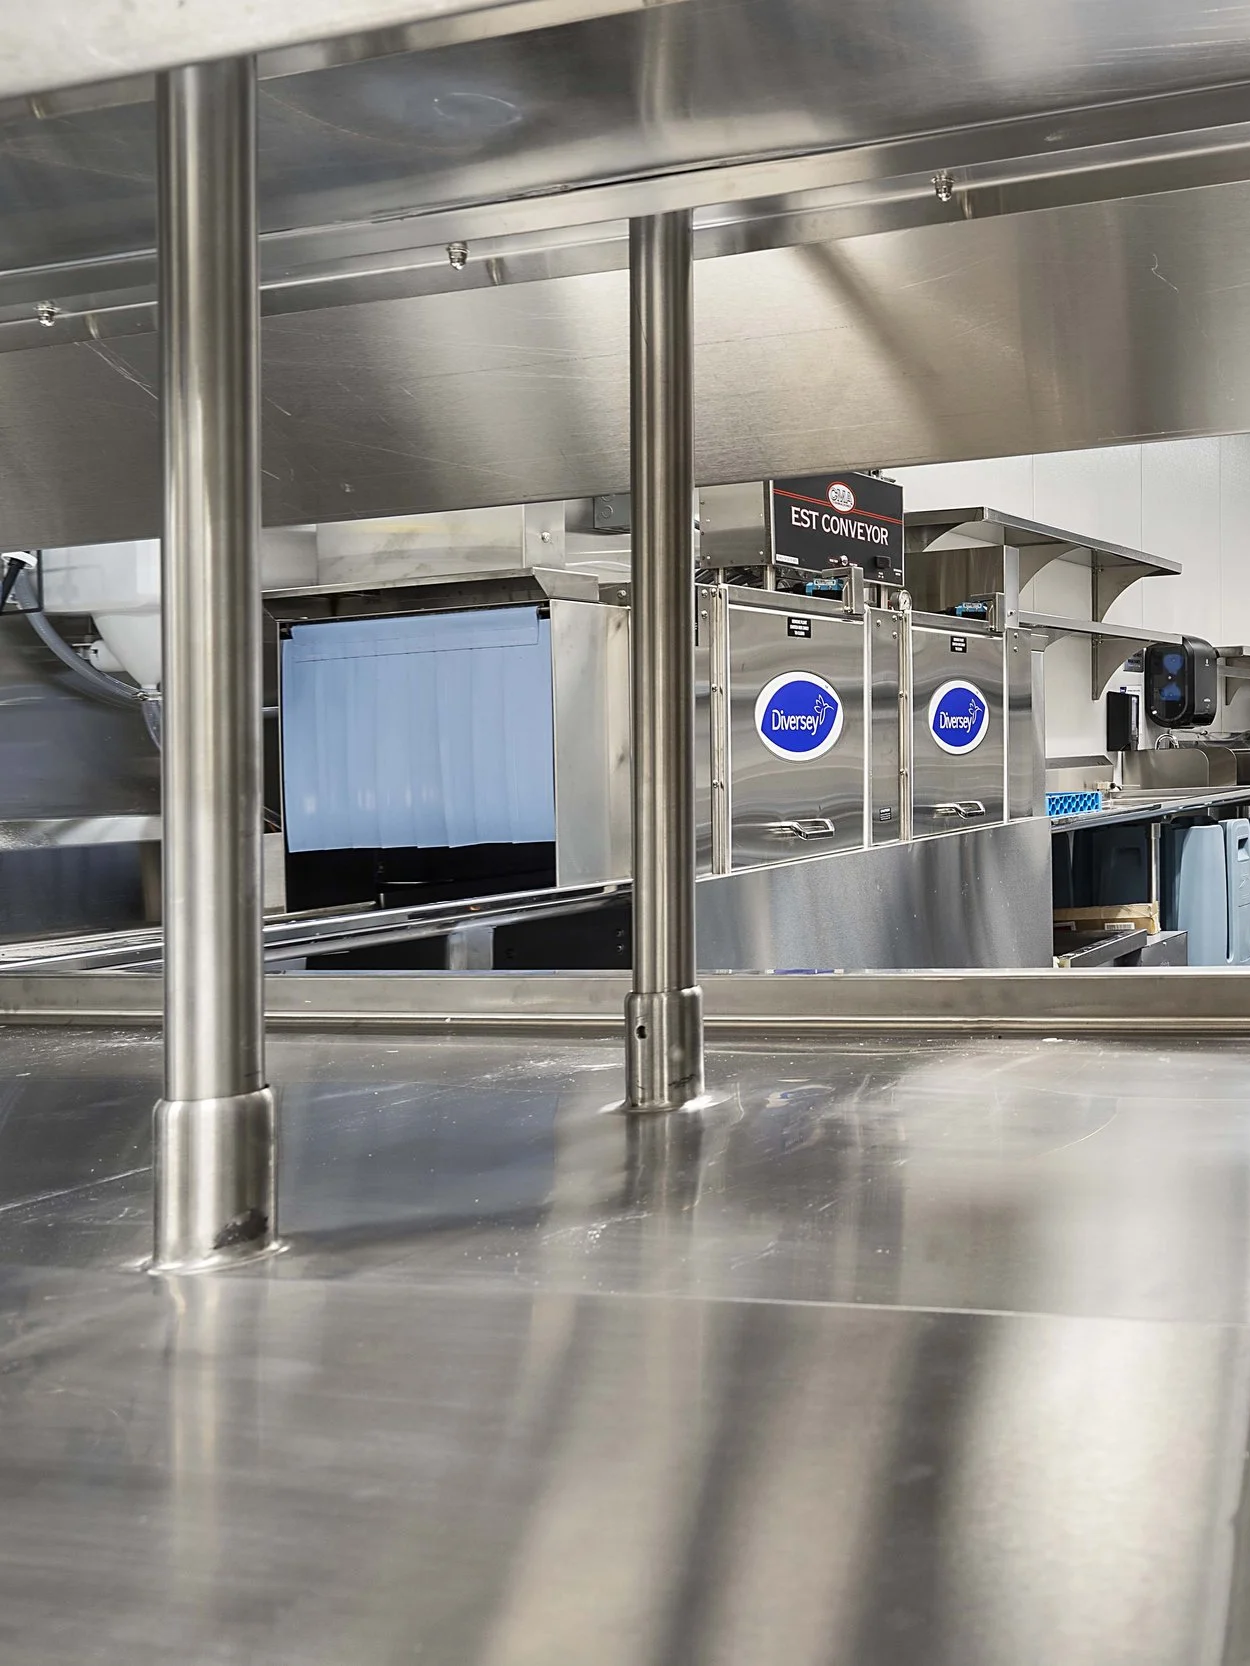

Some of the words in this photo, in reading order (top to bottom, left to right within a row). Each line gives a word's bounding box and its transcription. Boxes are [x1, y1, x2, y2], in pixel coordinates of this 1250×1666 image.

[791, 506, 819, 530] EST
[822, 514, 889, 546] CONVEYOR
[772, 709, 819, 735] Diversey
[940, 711, 972, 734] Diversey
